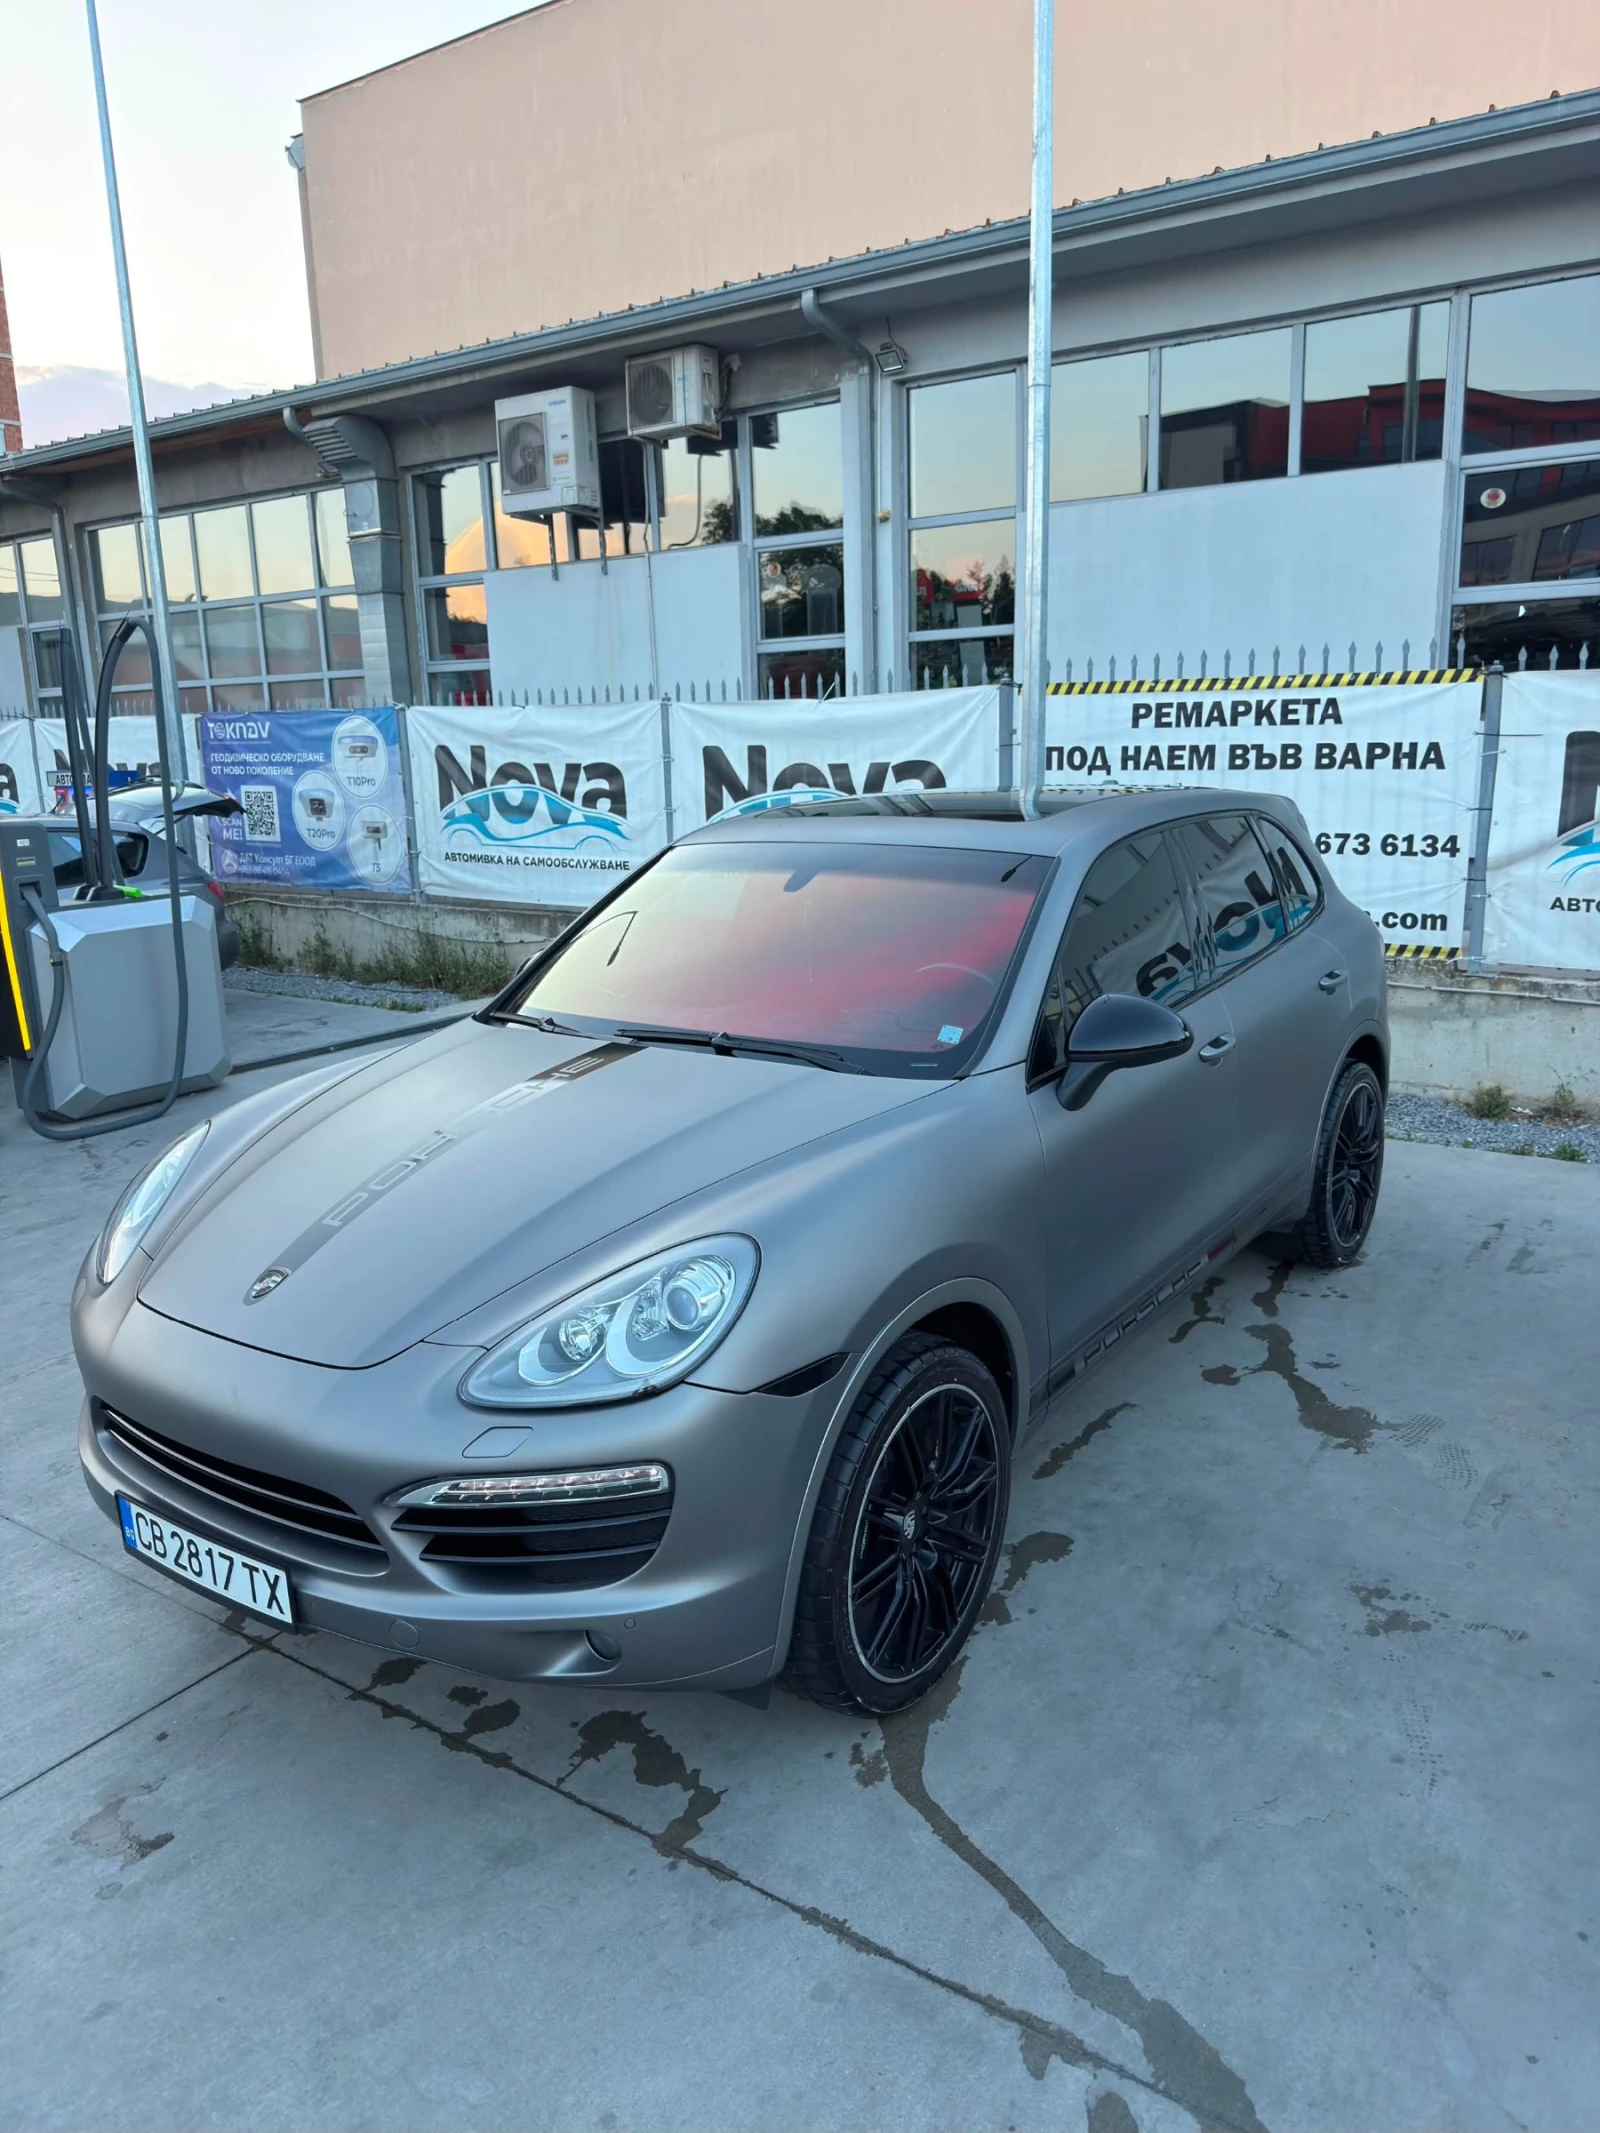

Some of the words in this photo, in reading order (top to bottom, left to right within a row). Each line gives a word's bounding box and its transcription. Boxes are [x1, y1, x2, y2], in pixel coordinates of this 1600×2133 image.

[1131, 697, 1343, 728] РЕМАРКЕТА
[1045, 745, 1111, 776] ПОД
[1120, 744, 1216, 771] НАЕМ
[1228, 743, 1302, 771] ВЪВ
[1314, 742, 1446, 771] ВАРНА
[211, 766, 222, 775] ОТ
[223, 766, 245, 775] НОВО
[246, 766, 294, 776] ПОКОЛЕНИЕ
[347, 776, 377, 788] T10Pro
[434, 744, 628, 825] Nova
[222, 818, 243, 827] SCAN
[223, 828, 244, 841] ME!
[306, 828, 336, 839] T20Pro
[1315, 832, 1371, 856] 673
[1380, 833, 1460, 858] 6134
[444, 852, 503, 865] АВТОМИВКА
[506, 856, 521, 866] НА
[523, 856, 630, 871] САМООБСЛУЖВАНЕ
[1550, 896, 1600, 914] АВТ
[125, 1525, 135, 1541] BG
